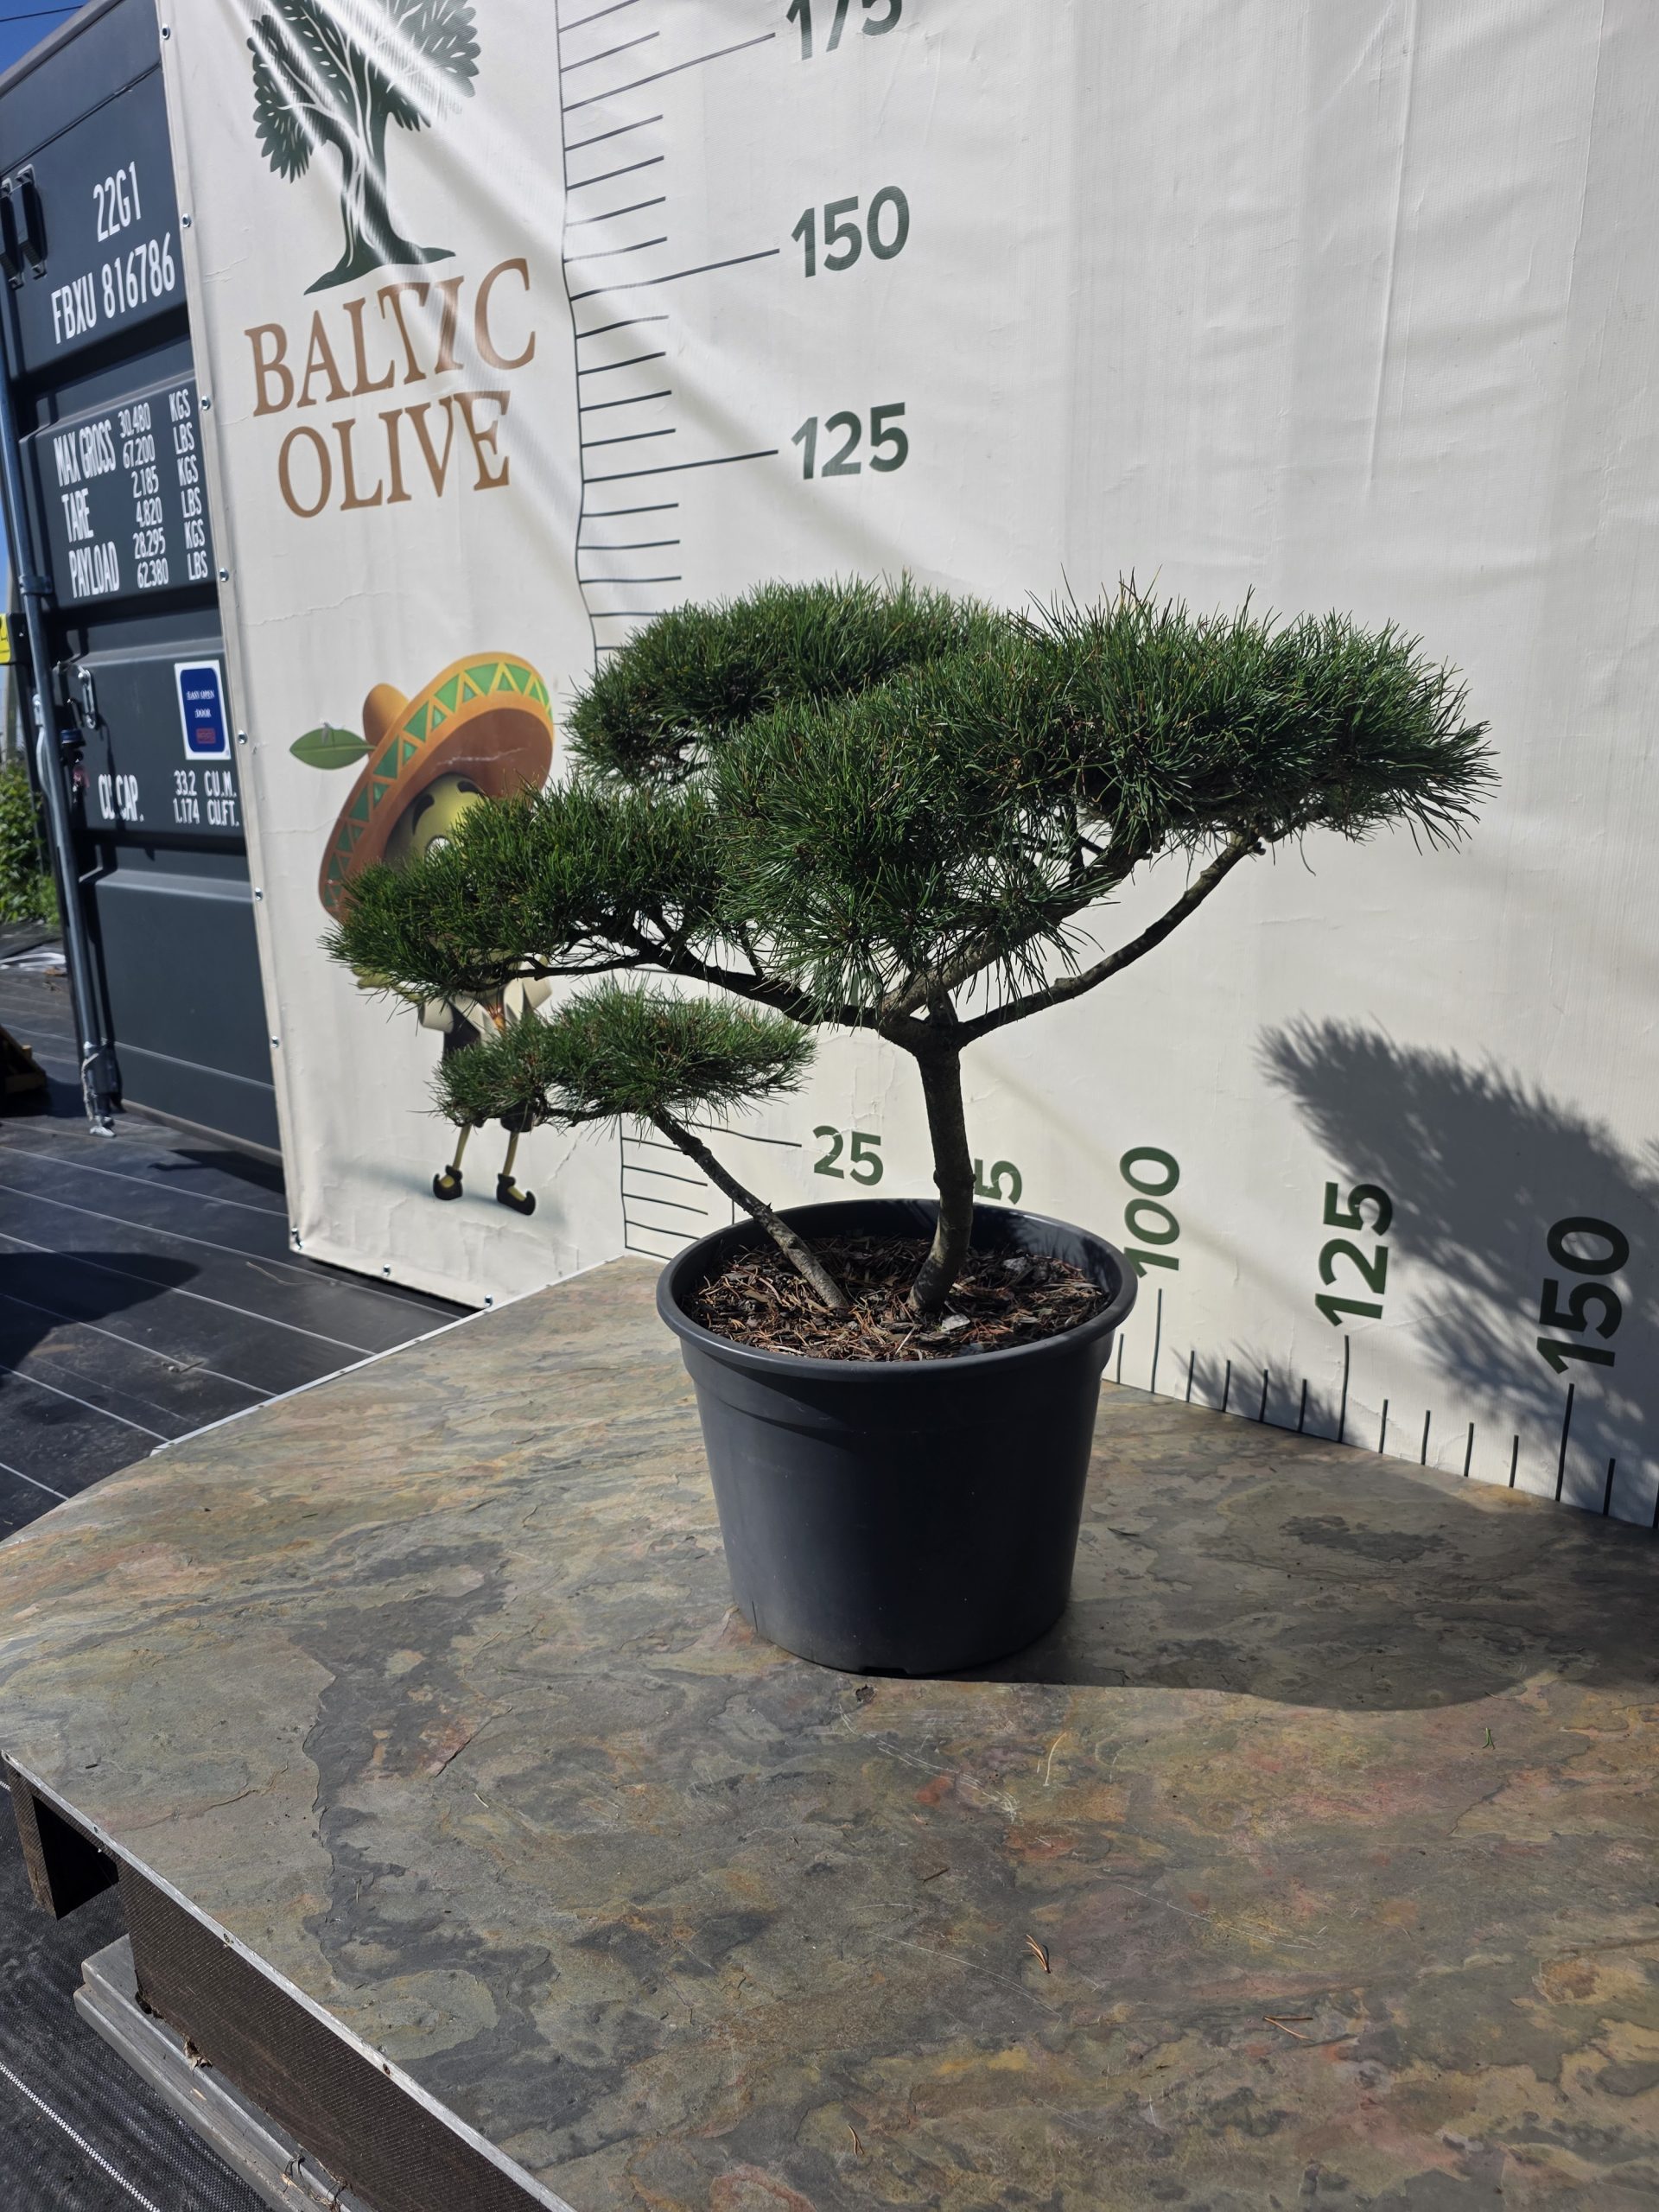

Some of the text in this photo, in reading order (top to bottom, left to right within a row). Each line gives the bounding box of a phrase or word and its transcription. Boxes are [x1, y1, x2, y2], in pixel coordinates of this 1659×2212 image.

[92, 161, 141, 242] 22G1
[791, 185, 910, 278] 150
[51, 232, 175, 344] FBXU 816786
[244, 257, 536, 417] BALTIC
[53, 431, 81, 487] MAX
[79, 419, 117, 479] GROSS
[168, 389, 191, 422] KGS
[173, 422, 195, 455] LBS
[278, 390, 511, 518] OLIVE
[791, 402, 909, 480] 125
[61, 487, 94, 543] TARE
[177, 454, 199, 486] KGS
[181, 486, 202, 518] LBS
[68, 541, 120, 599] PAYLOAD
[184, 518, 206, 550] KGS
[187, 550, 208, 581] LBS
[812, 1125, 884, 1186] 25
[1120, 1146, 1180, 1278] 100
[1315, 1181, 1393, 1326] 125
[1536, 1216, 1630, 1375] 150
